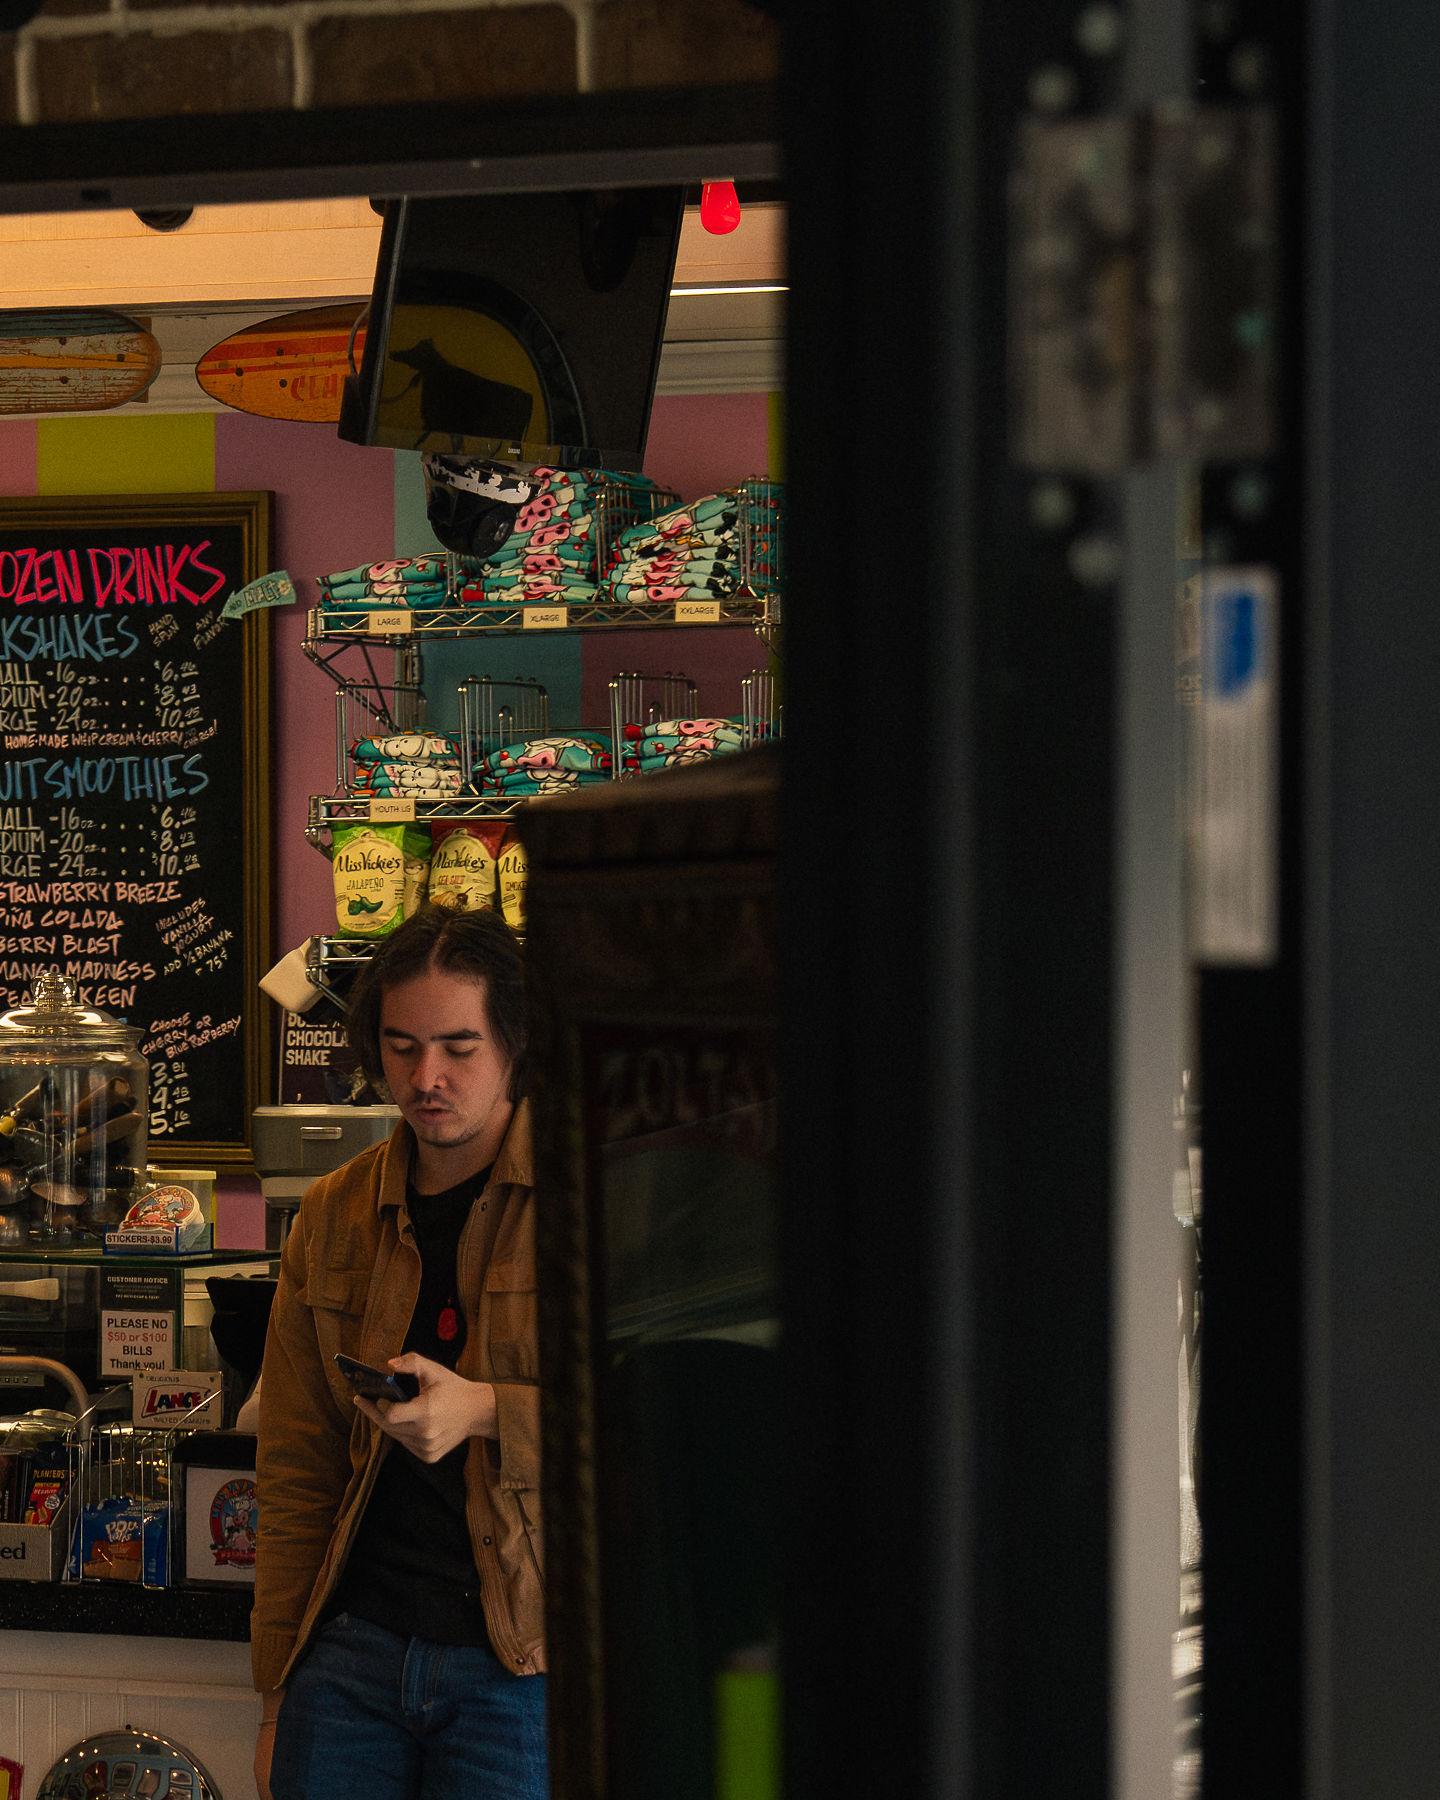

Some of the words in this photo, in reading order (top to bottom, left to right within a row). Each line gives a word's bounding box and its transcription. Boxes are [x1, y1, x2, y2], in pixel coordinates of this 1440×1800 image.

[86, 540, 225, 608] DRINKS
[377, 617, 401, 627] LARGE
[530, 613, 560, 625] XLARGE
[44, 753, 209, 802] SMOOTHIES
[114, 880, 182, 904] BREEZE
[40, 908, 125, 931] COLADA
[62, 933, 123, 957] BLAST
[65, 960, 157, 983] MADNESS
[78, 985, 138, 1008] KEEN
[285, 1049, 331, 1067] SHAKE
[107, 1317, 149, 1329] PLEASE
[152, 1319, 168, 1329] NO
[107, 1331, 127, 1343] $50
[129, 1334, 140, 1342] or
[142, 1332, 168, 1343] $100
[122, 1345, 153, 1356] BILLS
[110, 1358, 140, 1369] Thank
[144, 1359, 165, 1371] you!
[33, 1468, 65, 1480] PLANTERS
